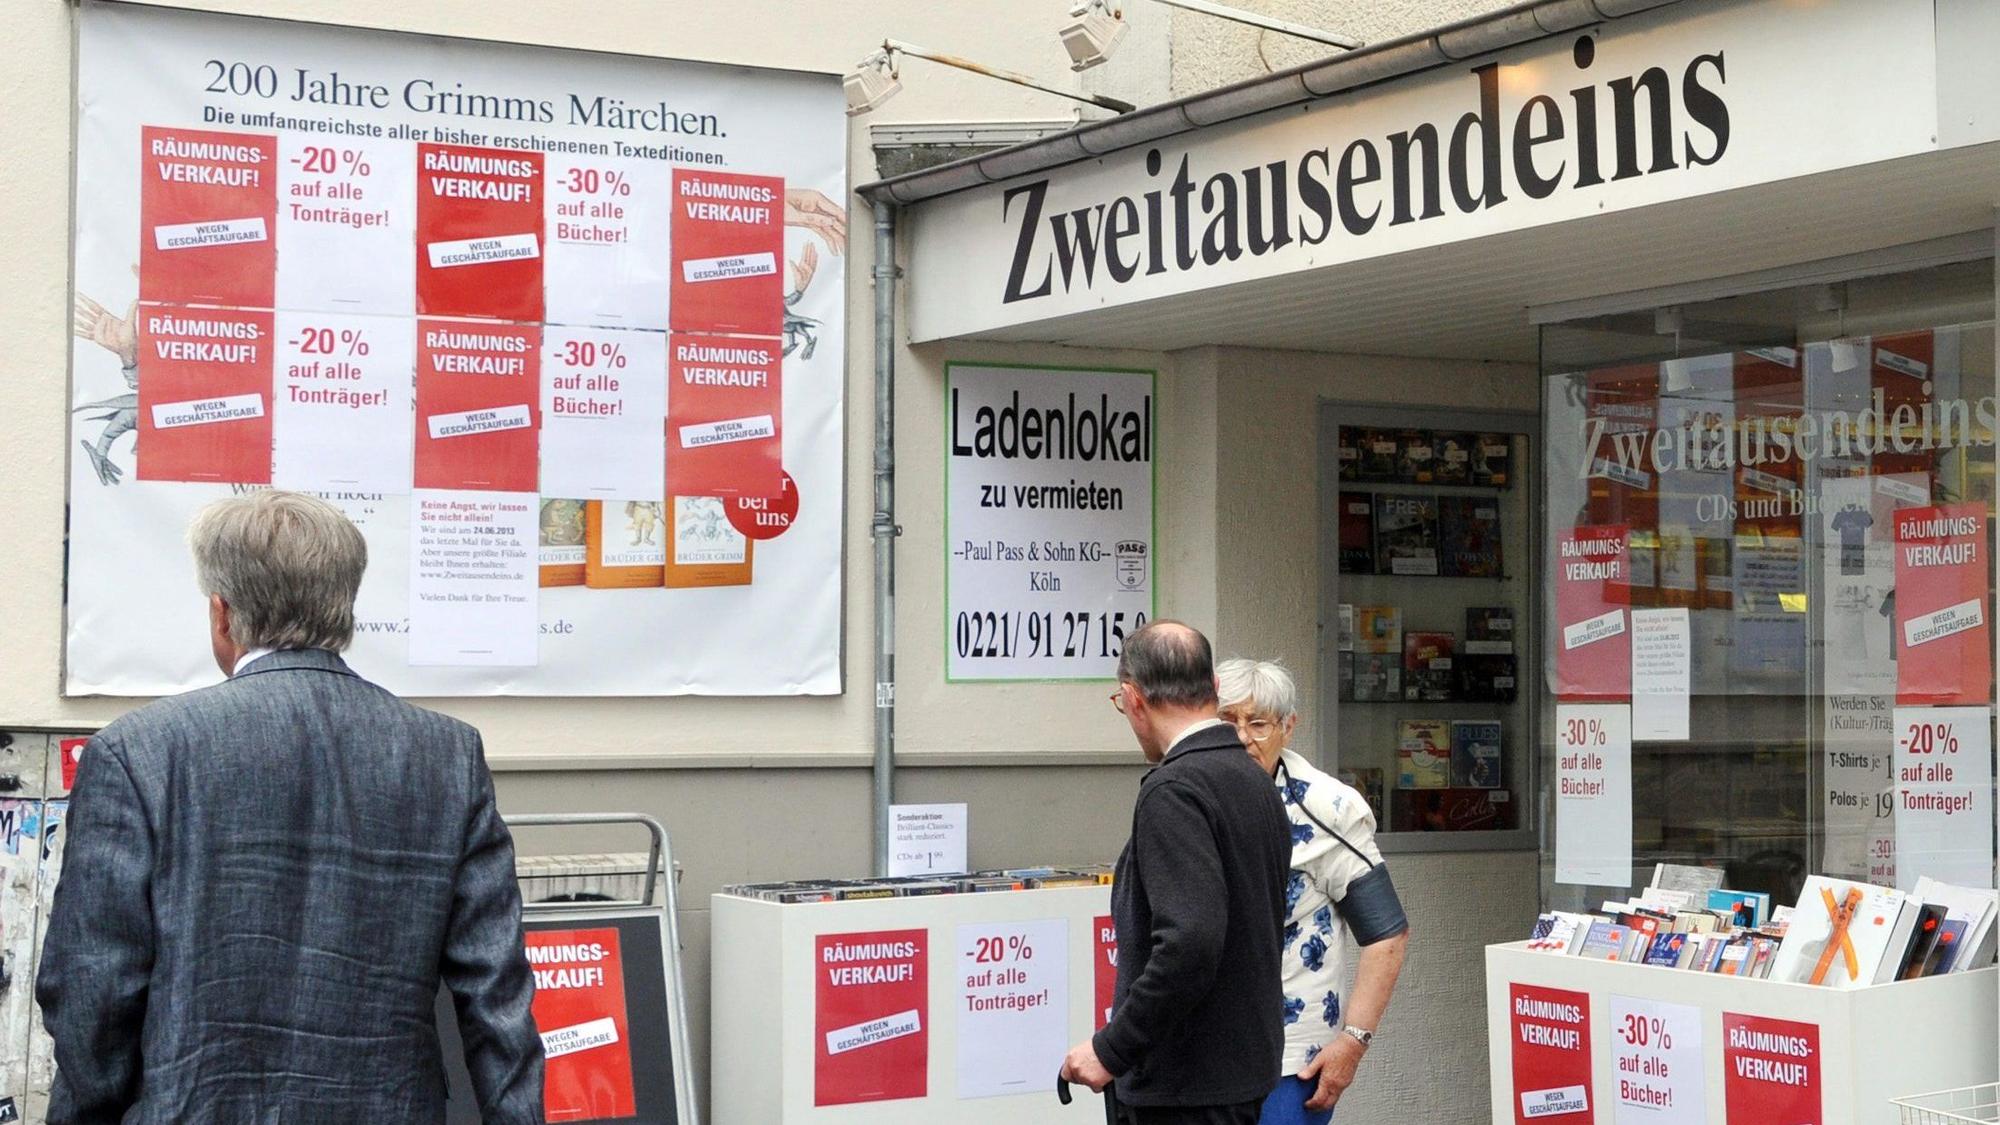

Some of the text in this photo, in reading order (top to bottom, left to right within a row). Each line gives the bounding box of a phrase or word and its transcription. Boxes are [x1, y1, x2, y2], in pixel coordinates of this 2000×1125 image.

[204, 59, 728, 138] 200 Jahre Grimms Märchen.
[204, 106, 728, 166] Die umfangreichste aller bisher erschienenen Texteditionen.
[152, 137, 268, 164] RÄUMUNGS-
[159, 161, 260, 187] VERKAUF!
[425, 151, 539, 179] RÄUMUNGS-
[1003, 35, 1730, 304] Zweitausendeins
[291, 180, 362, 201] auf alle
[432, 176, 530, 203] VERKAUF!
[680, 178, 777, 203] RÄUMUNGS-
[291, 203, 388, 229] Tonträger!
[557, 200, 624, 220] auf alle
[686, 202, 770, 226] VERKAUF!
[196, 224, 229, 235] WEGEN
[557, 222, 627, 244] Bücher!
[469, 240, 502, 252] WEGEN
[716, 257, 744, 269] WEGEN
[150, 315, 265, 340] RÄUMUNGS-
[157, 340, 256, 364] VERKAUF!
[426, 329, 531, 353] RÄUMUNGS-
[433, 353, 525, 376] VERKAUF!
[677, 344, 774, 366] RÄUMUNGS-
[288, 361, 361, 380] auf alle
[683, 366, 767, 388] VERKAUF!
[553, 374, 619, 393] auf alle
[193, 401, 227, 413] WEGEN
[288, 384, 388, 410] Tonträger!
[553, 395, 623, 417] Bücher!
[465, 411, 496, 424] WEGEN
[713, 421, 743, 434] WEGEN
[952, 388, 1151, 462] Ladenlokal
[1578, 381, 1999, 480] Zweitausendeins
[420, 500, 448, 511] Keine
[480, 502, 496, 511] wir
[498, 502, 528, 512] lassen
[980, 479, 1123, 511] zu vermieten
[420, 512, 493, 523] Sie nicht allein!
[1697, 494, 1738, 523] CDs
[1743, 493, 1782, 519] und
[1900, 516, 1981, 540] RÄUMUNGS-
[997, 543, 1024, 562] Pass
[1028, 543, 1039, 562] &
[1044, 541, 1075, 562] Sohn
[1118, 543, 1146, 554] PASS
[1561, 537, 1625, 558] RÄUMUNGS-
[1905, 543, 1976, 567] VERKAUF!
[1030, 571, 1061, 592] Köln
[1565, 562, 1621, 581] VERKAUF!
[1586, 619, 1605, 632] WEGEN
[1932, 610, 1956, 625] WEGEN
[956, 611, 1021, 658] 0221/
[1028, 612, 1054, 658] 91
[1063, 612, 1090, 658] 27
[1830, 696, 1886, 710] Werden Sie
[1830, 714, 1894, 733] (Kultur-)Träg
[1561, 753, 1602, 770] auf alle
[1830, 752, 1881, 771] T-Shirts je
[1901, 763, 1953, 782] auf alle
[1561, 777, 1605, 795] Bücher!
[1830, 790, 1857, 806] Polos
[1859, 793, 1870, 810] je
[1901, 790, 1972, 815] Tonträger!
[823, 941, 920, 964] RÄUMUNGS-
[829, 965, 913, 987] VERKAUF!
[966, 969, 1027, 988] auf alle
[966, 989, 1048, 1013] Tonträger!
[1515, 995, 1584, 1024] RÄUMUNGS-
[545, 1030, 579, 1044] WEGEN
[860, 1020, 889, 1035] WEGEN
[1519, 1023, 1580, 1051] VERKAUF!
[1730, 1025, 1813, 1058] RÄUMUNGS-
[1619, 1054, 1668, 1078] auf alle
[1735, 1055, 1808, 1087] VERKAUF!
[1544, 1091, 1565, 1101] WEGEN
[1620, 1080, 1673, 1108] Bücher!
